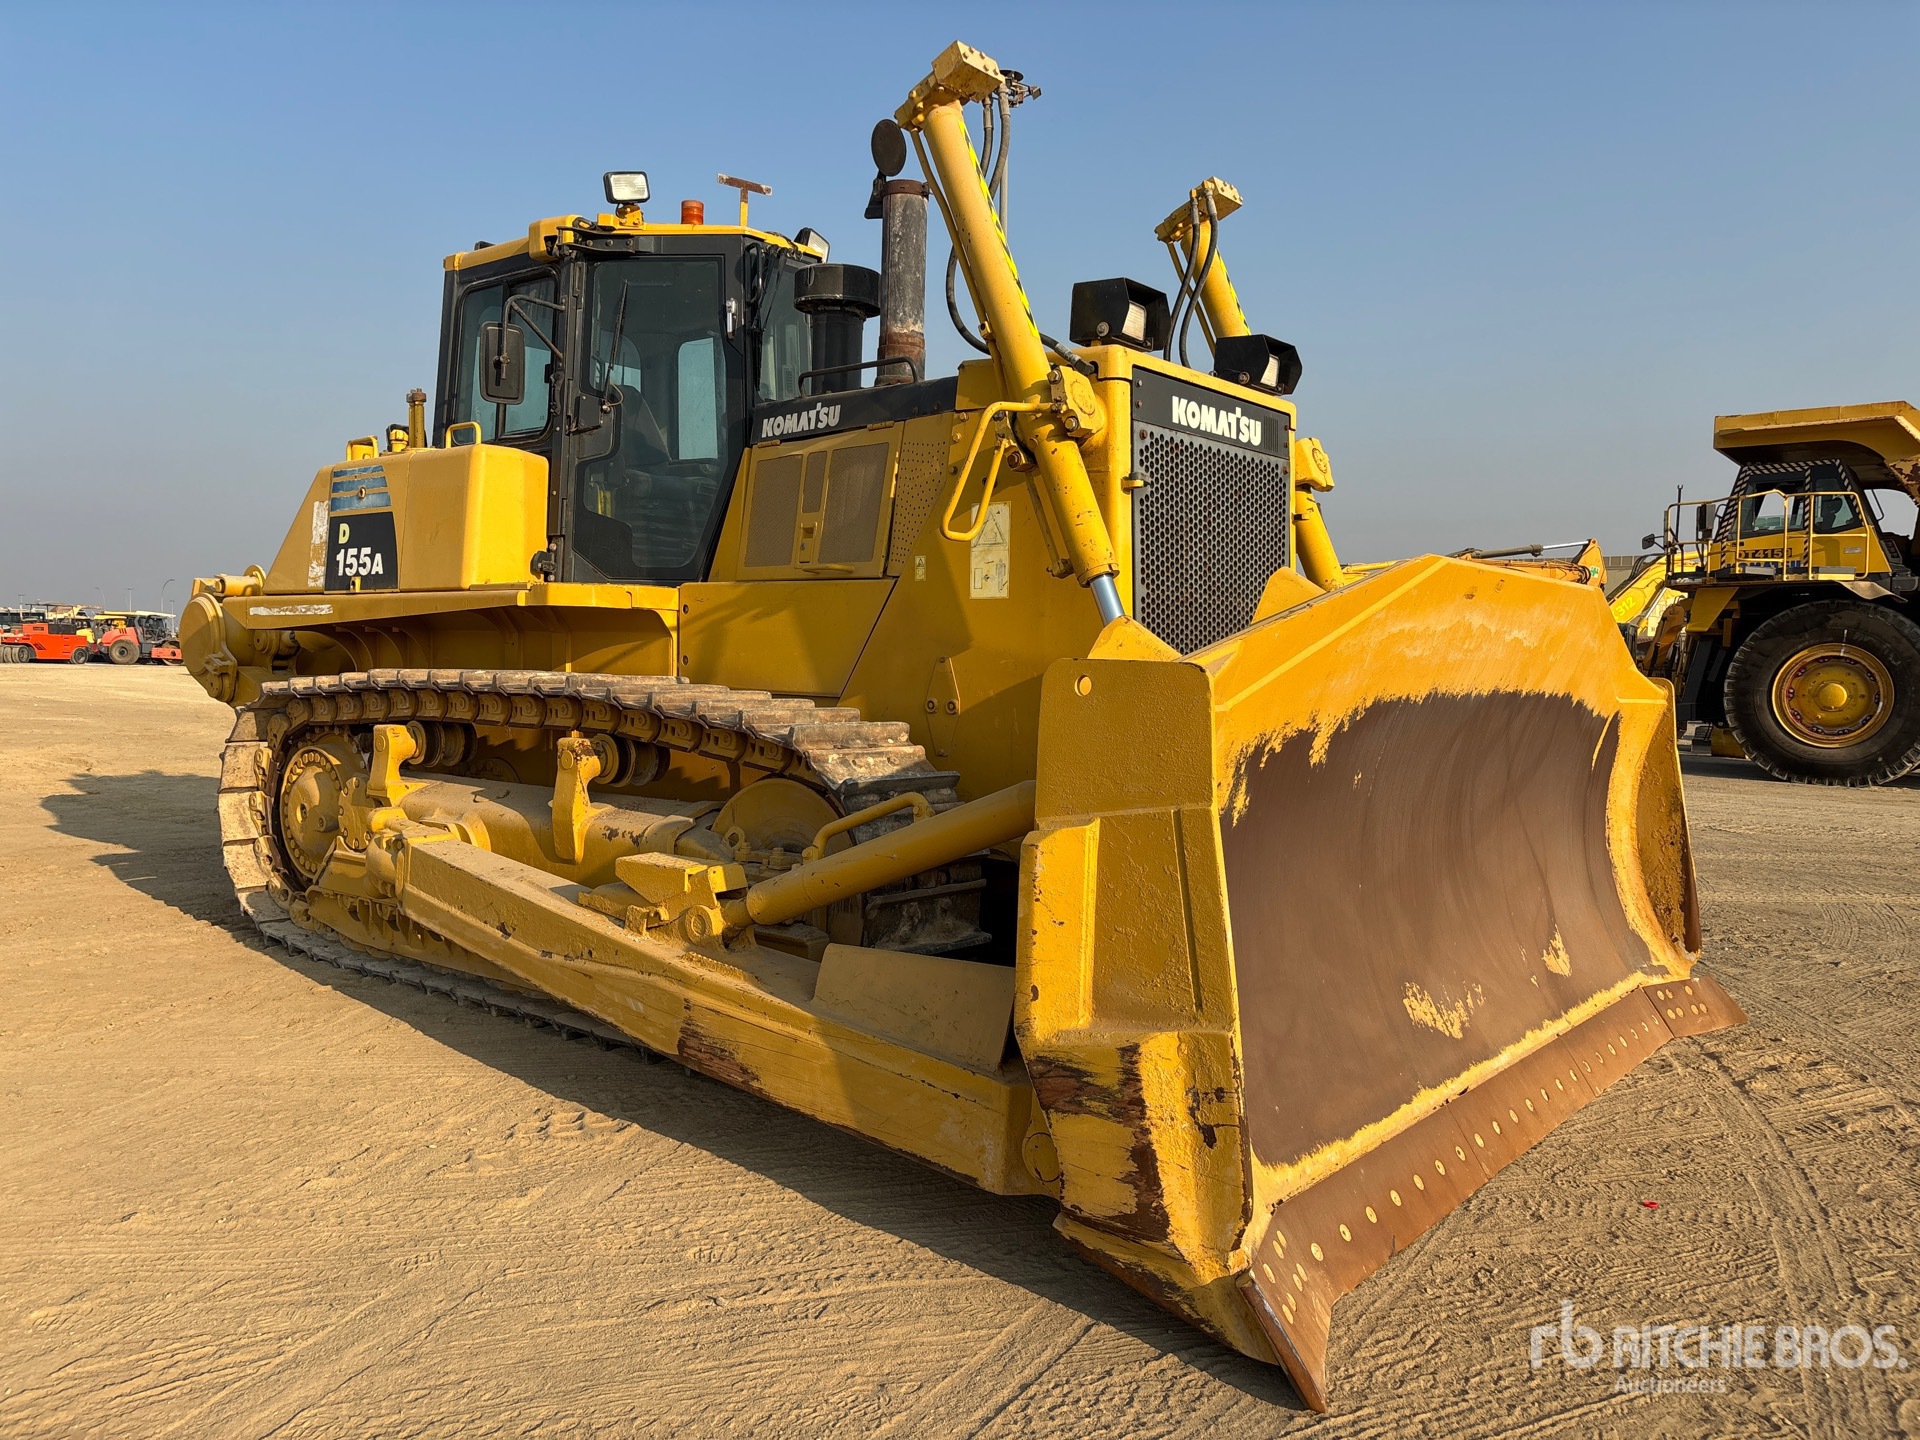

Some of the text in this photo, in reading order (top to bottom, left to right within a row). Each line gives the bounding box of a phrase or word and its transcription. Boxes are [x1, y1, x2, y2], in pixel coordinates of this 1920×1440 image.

[761, 402, 841, 438] KOMATSU
[1171, 395, 1262, 447] KOMATSU
[338, 523, 350, 544] D
[336, 547, 384, 576] 155A
